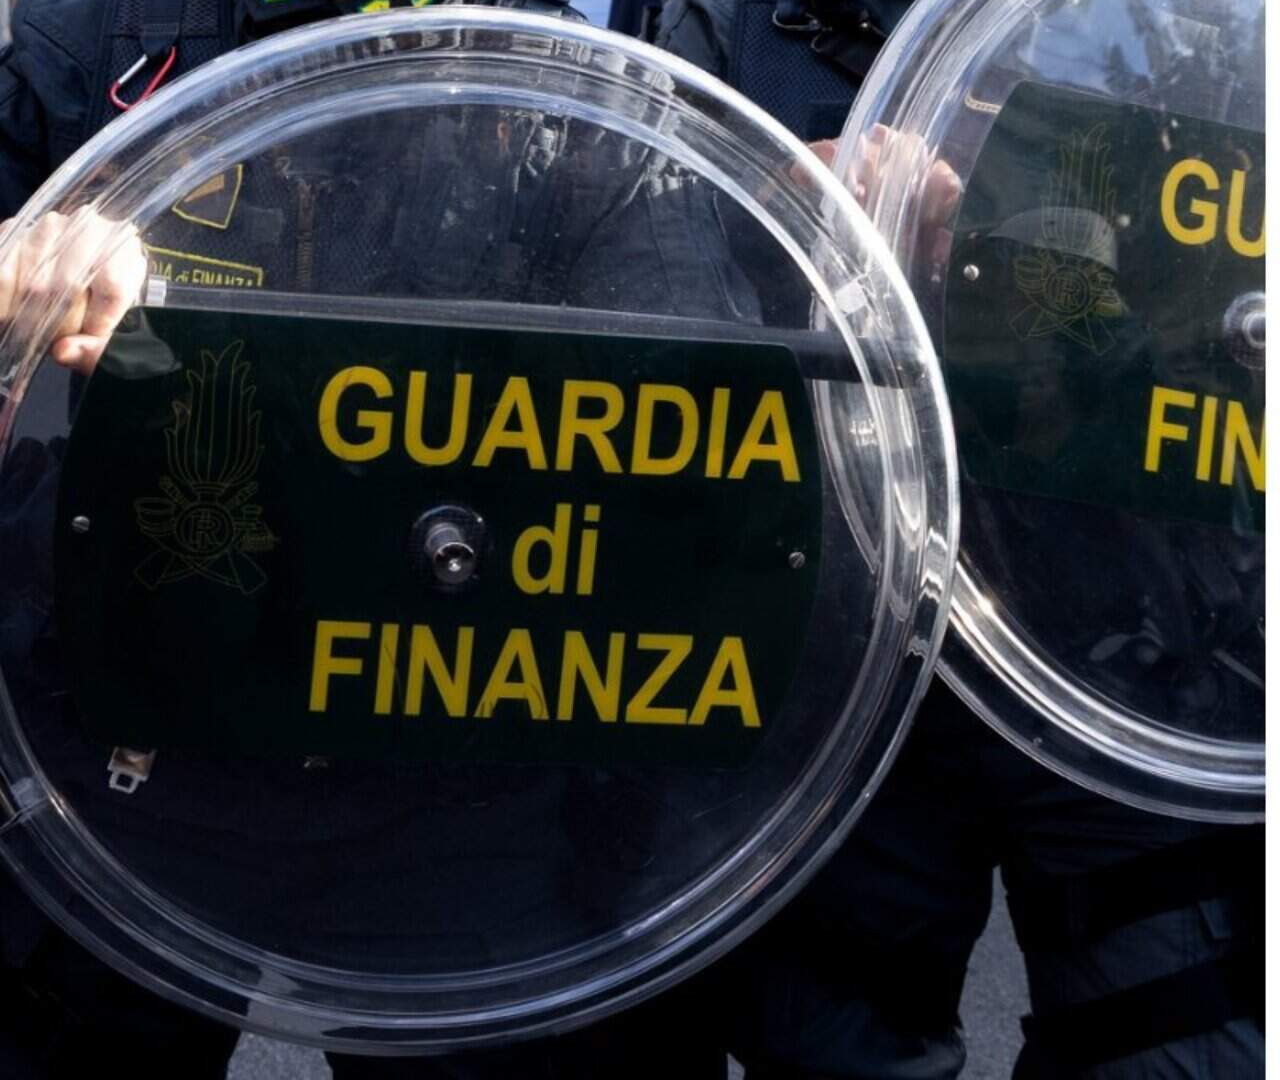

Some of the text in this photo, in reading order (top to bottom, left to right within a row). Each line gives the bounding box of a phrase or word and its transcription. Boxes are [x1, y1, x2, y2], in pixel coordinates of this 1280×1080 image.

[317, 366, 802, 483] GUARDIA
[511, 503, 601, 596] di
[308, 620, 763, 728] FINANZA
